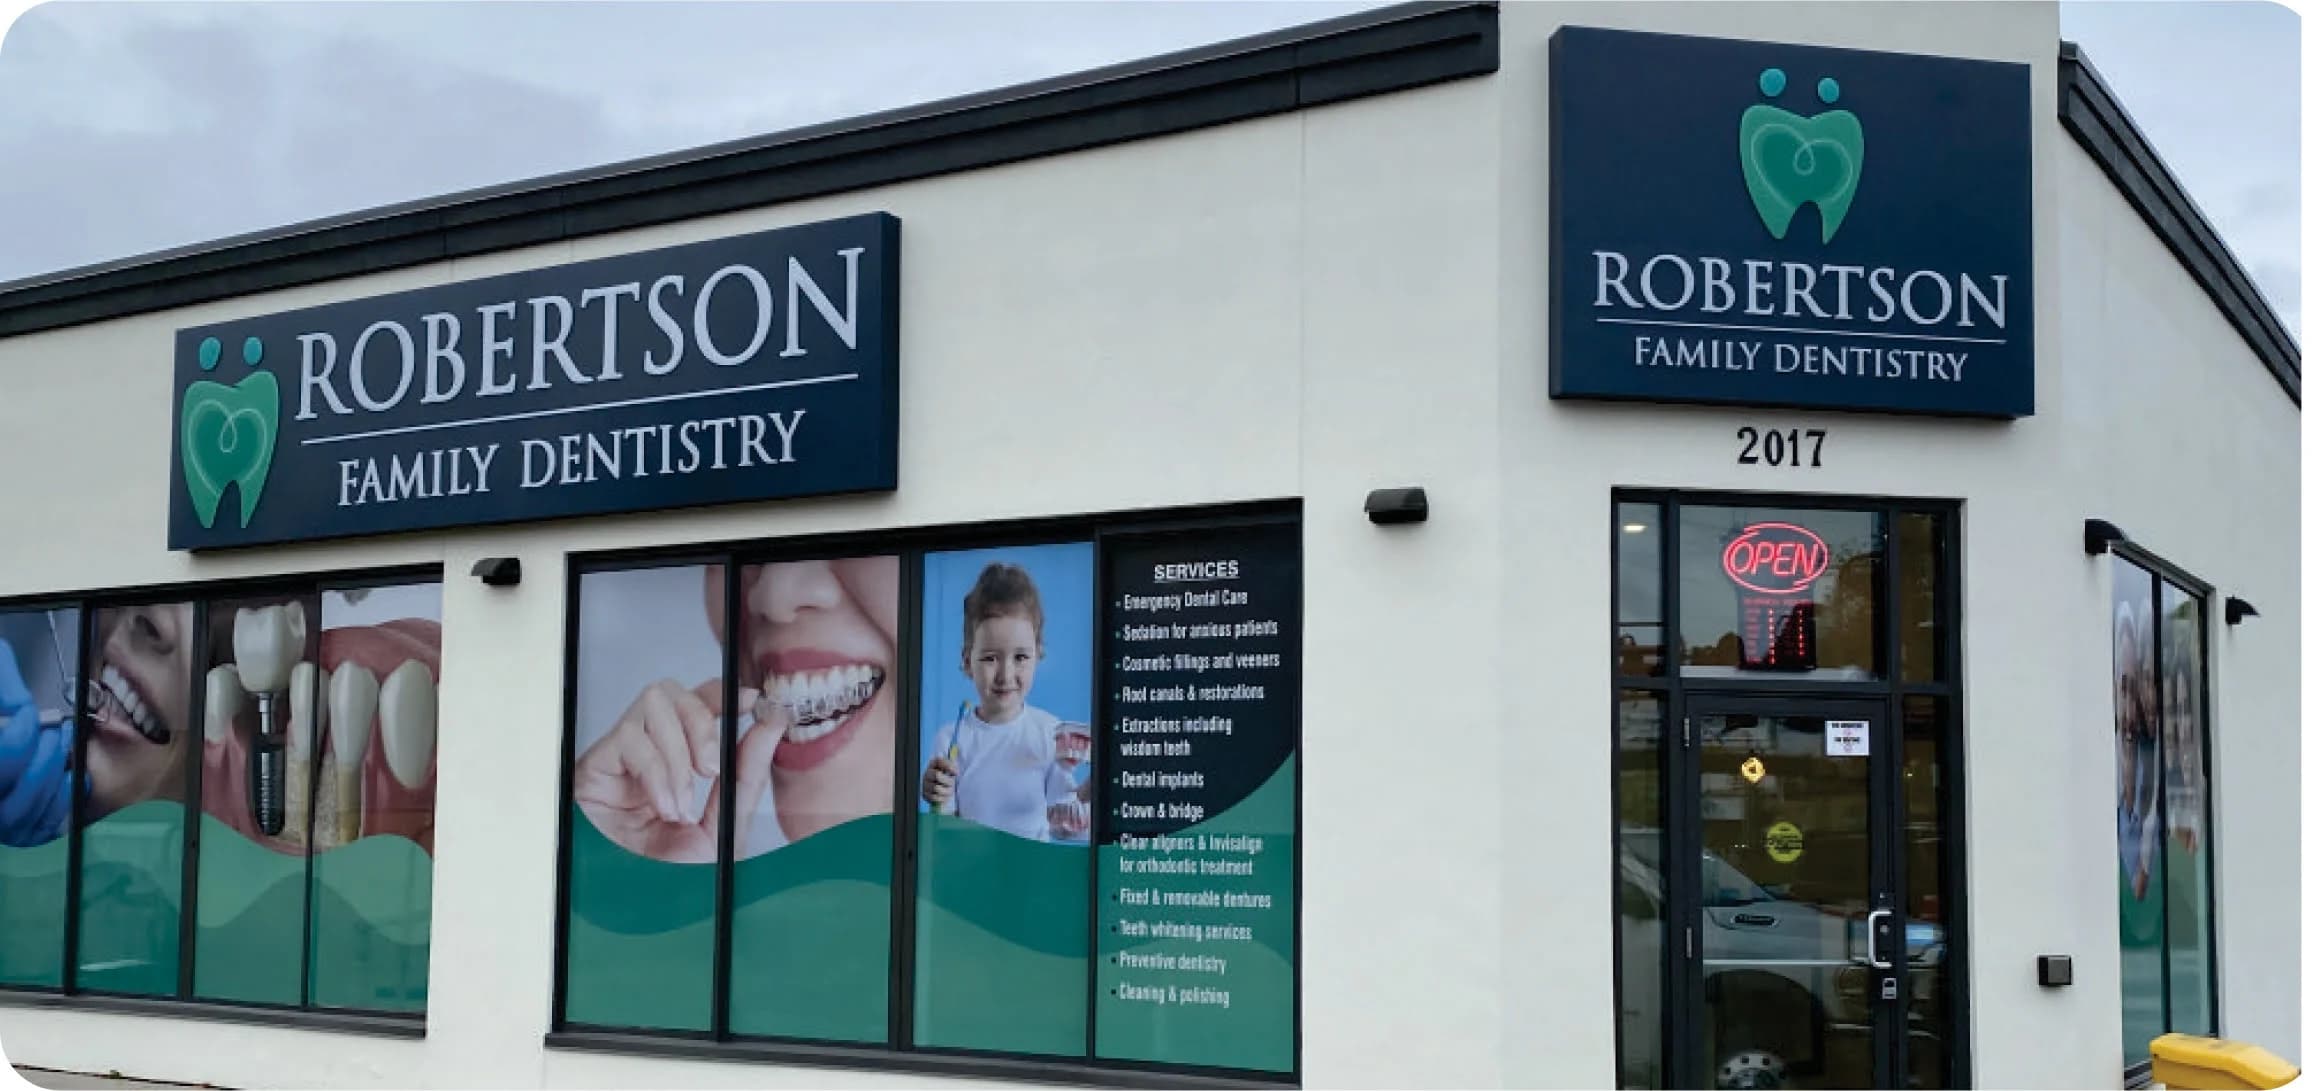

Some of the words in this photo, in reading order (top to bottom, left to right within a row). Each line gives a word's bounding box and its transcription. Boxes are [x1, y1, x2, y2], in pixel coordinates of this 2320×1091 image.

[1593, 250, 2008, 329] ROBERTSON
[295, 247, 865, 421] ROBERTSON
[1634, 337, 1762, 371] FAMILY
[1775, 343, 1968, 382] DENTISTRY
[1736, 426, 1827, 466] 2017
[338, 443, 499, 506] FAMILY
[520, 410, 806, 489] DENTISTRY
[1732, 541, 1819, 577] OPEN
[1154, 560, 1239, 580] SERVICES
[1124, 594, 1181, 612] Emergency
[1185, 590, 1220, 607] Dental
[1222, 590, 1248, 605] Care
[1123, 624, 1169, 641] Sedation
[1172, 622, 1186, 638] for
[1190, 622, 1231, 639] anxious
[1234, 620, 1278, 639] patients
[1122, 655, 1171, 671] Cosmetic
[1174, 654, 1208, 672] fillings
[1212, 652, 1234, 668] and
[1123, 686, 1146, 702] Root
[1150, 685, 1184, 700] canals
[1187, 684, 1195, 700] &
[1200, 684, 1264, 700] restorations
[1122, 716, 1180, 733] Extractions
[1183, 716, 1232, 735] including
[1120, 740, 1161, 756] wisdom
[1164, 739, 1190, 756] teeth
[1122, 771, 1155, 788] Dental
[1158, 772, 1204, 790] implants
[1122, 803, 1154, 818] Crown
[1157, 803, 1165, 818] &
[1169, 803, 1204, 822] bridge
[1120, 833, 1147, 850] Clear
[1152, 833, 1194, 854] aligners
[1199, 834, 1206, 850] &
[1120, 856, 1134, 873] for
[1136, 857, 1197, 874] orthodontic
[1200, 858, 1252, 875] treatment
[1120, 888, 1149, 905] Fixed
[1152, 890, 1160, 905] &
[1164, 890, 1220, 907] removable
[1224, 891, 1271, 908] dentures
[1120, 920, 1148, 936] Teeth
[1152, 920, 1202, 942] whitening
[1205, 923, 1252, 940] services
[1120, 951, 1175, 969] Preventive
[1178, 954, 1226, 974] dentistry
[1120, 982, 1165, 1004] Cleaning
[1168, 985, 1176, 1001] &
[1180, 986, 1229, 1008] polishing
